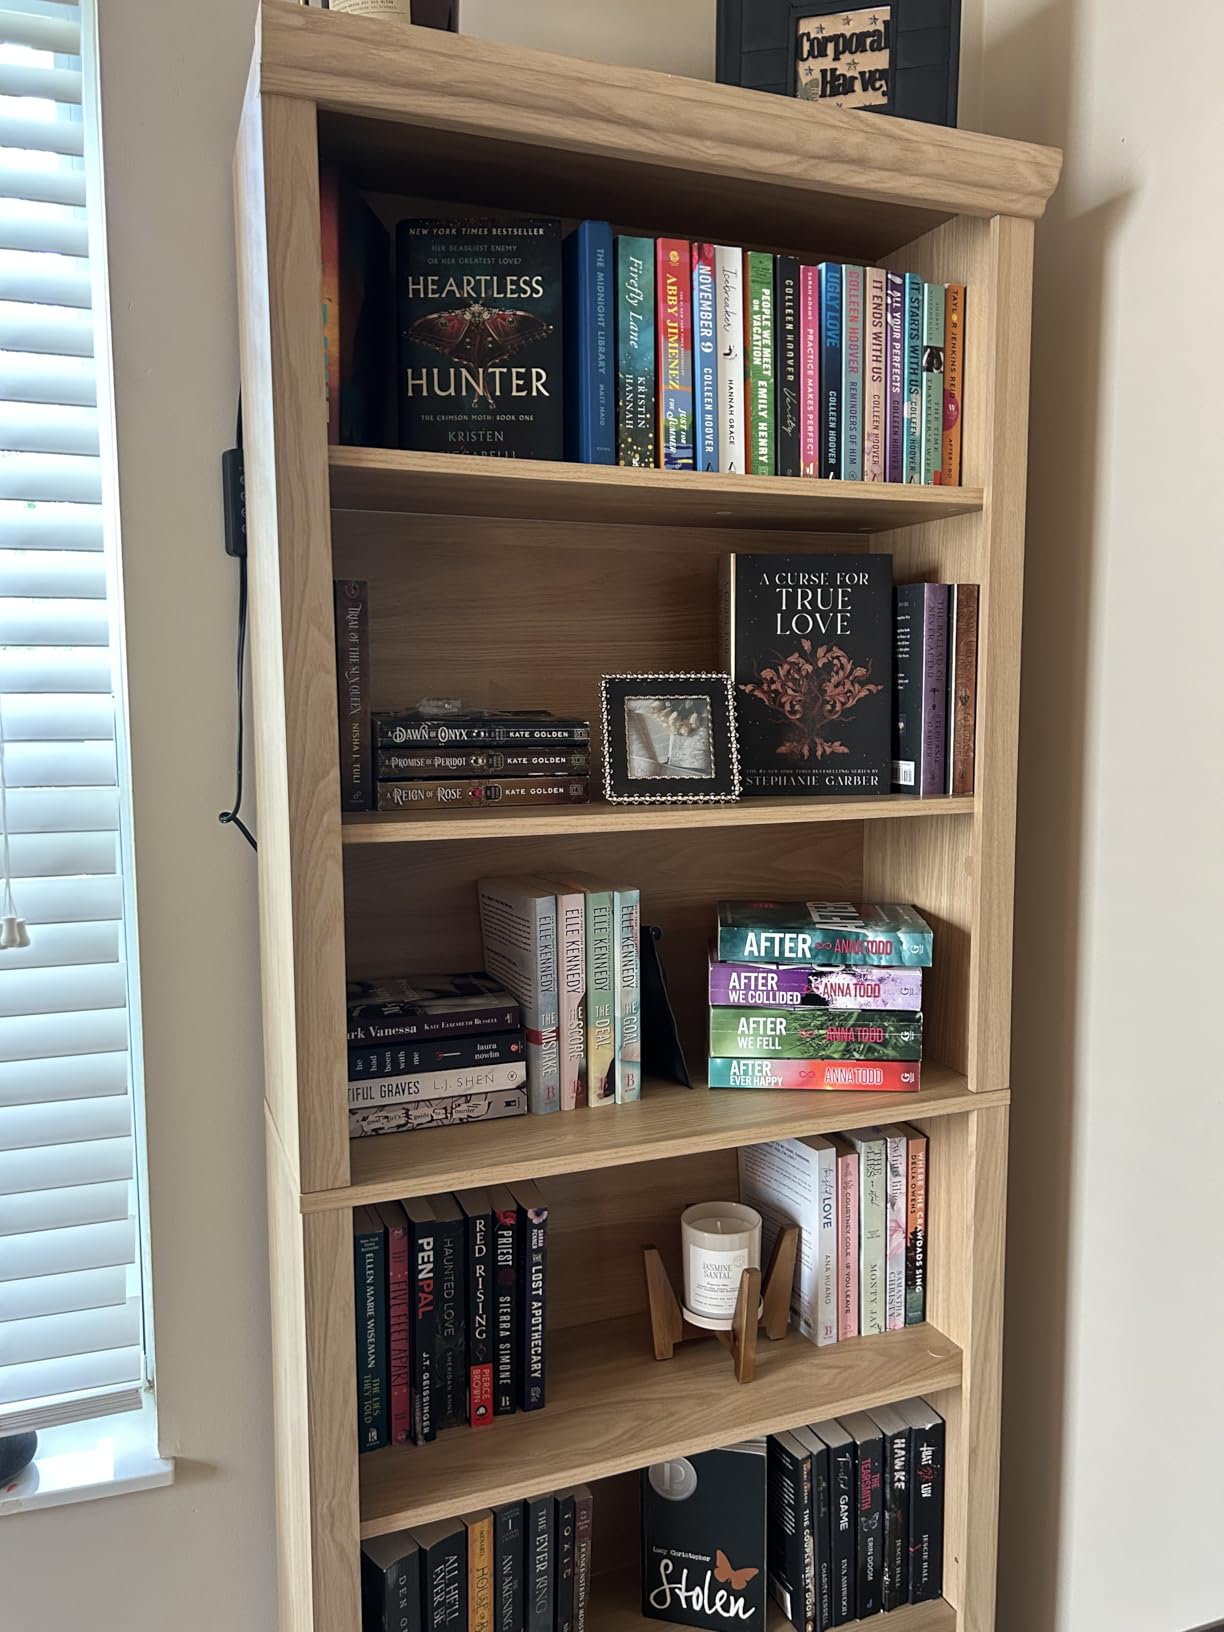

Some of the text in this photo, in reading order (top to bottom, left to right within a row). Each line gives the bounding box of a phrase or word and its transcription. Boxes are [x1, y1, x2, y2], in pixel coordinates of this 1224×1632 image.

[798, 19, 890, 62] Corporal
[408, 276, 544, 298] HEARTLESS
[626, 256, 643, 349] Firefly Lane
[698, 265, 713, 353] NOVEMBER 9
[721, 266, 737, 337] Icebreaker
[827, 272, 840, 348] UGLY LOVE
[596, 248, 606, 376] THE MIDNIGHT LIBRARY
[666, 273, 680, 390] ABBY JIMENEZ
[752, 299, 762, 365] ON VACATION
[762, 288, 771, 376] PEOPLE WE MEET
[848, 271, 859, 374] COLLEEN HOOVER
[871, 280, 883, 383] IT ENDS WITH US
[908, 281, 920, 395] IT STARTS WITH US
[406, 367, 550, 396] HUNTER
[625, 375, 633, 429] HANNAH
[638, 376, 646, 428] KRISTIN
[704, 368, 713, 453] COLLEEN HOOVER
[758, 381, 769, 463] EMILY HENRY
[781, 387, 797, 437] Verity
[828, 391, 837, 464] COLLEEN HOOVER
[849, 381, 857, 465] REMINDERS OF HIM
[448, 431, 504, 442] KRISTEN
[759, 572, 869, 585] A CURSE FOR
[776, 588, 852, 610] TRUE
[776, 613, 851, 635] LOVE
[746, 776, 878, 785] STEPHANIE GARBER
[565, 909, 581, 994] ELLE KENNEDY
[593, 907, 608, 991] ELLE KENNEDY
[621, 905, 634, 989] ELLE KENNEDY
[743, 932, 812, 958] AFTER
[834, 940, 893, 956] ANNA TODD
[728, 991, 801, 1004] WE COLLIDED
[729, 973, 778, 991] AFTER
[823, 983, 881, 998] ANNA TODD
[567, 1021, 584, 1062] SCORE
[595, 1019, 610, 1050] DEAL
[623, 1016, 637, 1047] GOAL
[738, 1017, 786, 1035] AFTER
[738, 1037, 781, 1049] WE FELL
[826, 1028, 883, 1043] ANNA TODD
[474, 1051, 500, 1060] nowlin
[542, 1026, 556, 1077] MISTAKE
[730, 1061, 771, 1076] AFTER
[433, 1073, 495, 1092] L.J. SHEN
[730, 1076, 783, 1087] EVER HAPPY
[824, 1068, 883, 1084] ANNA TODD
[823, 1197, 832, 1229] LOVE
[497, 1230, 513, 1266] PRIEST
[916, 1211, 924, 1266] CRAWDADS
[365, 1252, 373, 1283] ELLEN
[417, 1236, 434, 1320] PENPAL
[475, 1219, 486, 1339] RED RISING
[704, 1271, 731, 1279] SANTAL
[824, 1275, 832, 1305] HUANG
[366, 1285, 374, 1317] MARIE
[530, 1266, 542, 1378] LOST APOTHECARY
[367, 1320, 375, 1368] WISEMAN
[499, 1296, 511, 1385] SIERRA SIMONE
[422, 1352, 430, 1434] J.T. GEISSINGER
[473, 1369, 481, 1402] BROWN
[482, 1369, 490, 1400] PIERCE
[861, 1458, 871, 1511] TEARSMITH
[871, 1472, 880, 1489] THE
[893, 1438, 906, 1490] HAWKE
[536, 1508, 548, 1614] THE EVER KING
[652, 1546, 711, 1562] Lucy Christopher
[433, 1565, 445, 1628] EVER BE
[445, 1555, 459, 1625] ALL HE'LL
[650, 1558, 756, 1620] Stolen
